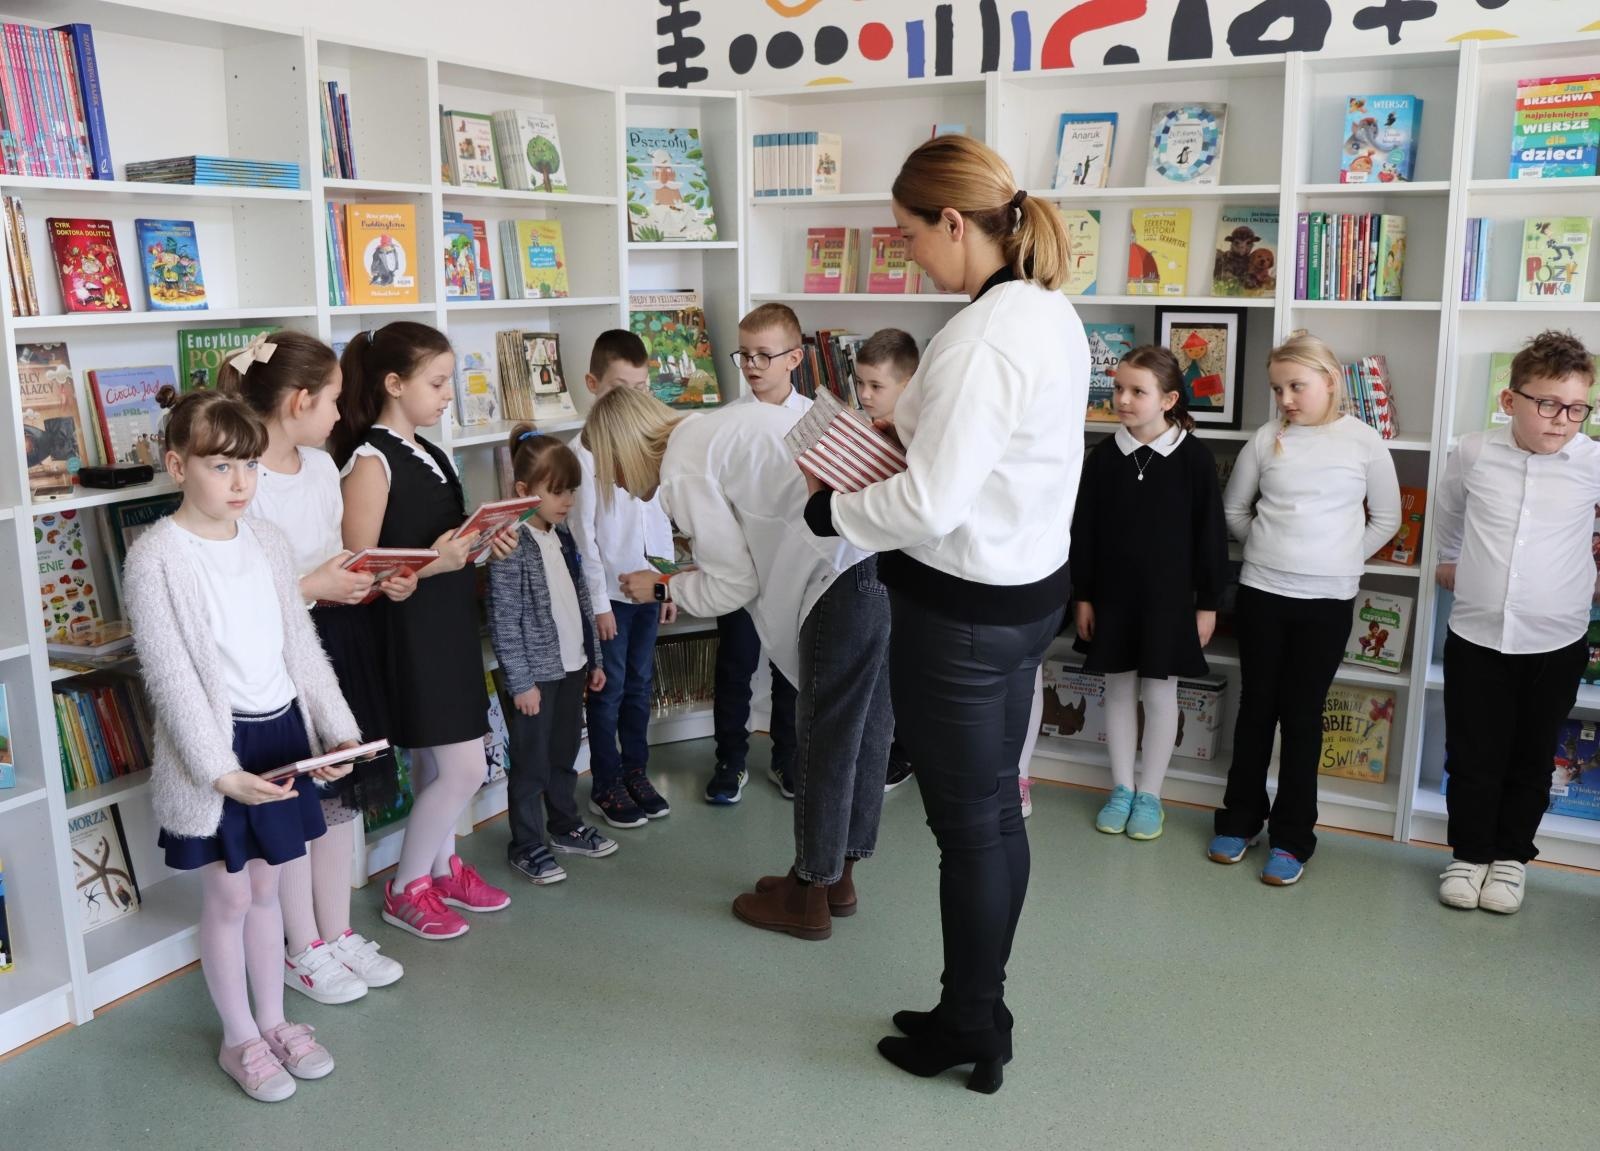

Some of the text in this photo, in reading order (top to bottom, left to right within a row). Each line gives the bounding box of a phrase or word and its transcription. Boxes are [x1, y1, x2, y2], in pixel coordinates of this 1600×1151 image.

[1523, 92, 1594, 106] BRZECHWA
[1522, 119, 1590, 134] WIERSZE
[630, 132, 688, 153] Pszczoły
[1072, 131, 1100, 140] Anaruk
[1545, 135, 1567, 145] dla
[1521, 146, 1584, 161] dzieci
[1144, 226, 1175, 234] HISTORIA
[825, 240, 844, 248] OTO
[823, 251, 843, 259] JEST
[20, 372, 40, 384] ELCY
[20, 382, 55, 395] ALAZCY
[105, 385, 140, 405] Ciocia
[39, 560, 65, 574] ENIE
[1320, 715, 1376, 737] OBIETY
[1322, 744, 1371, 768] ŚWIAT
[68, 809, 108, 834] MORZA
